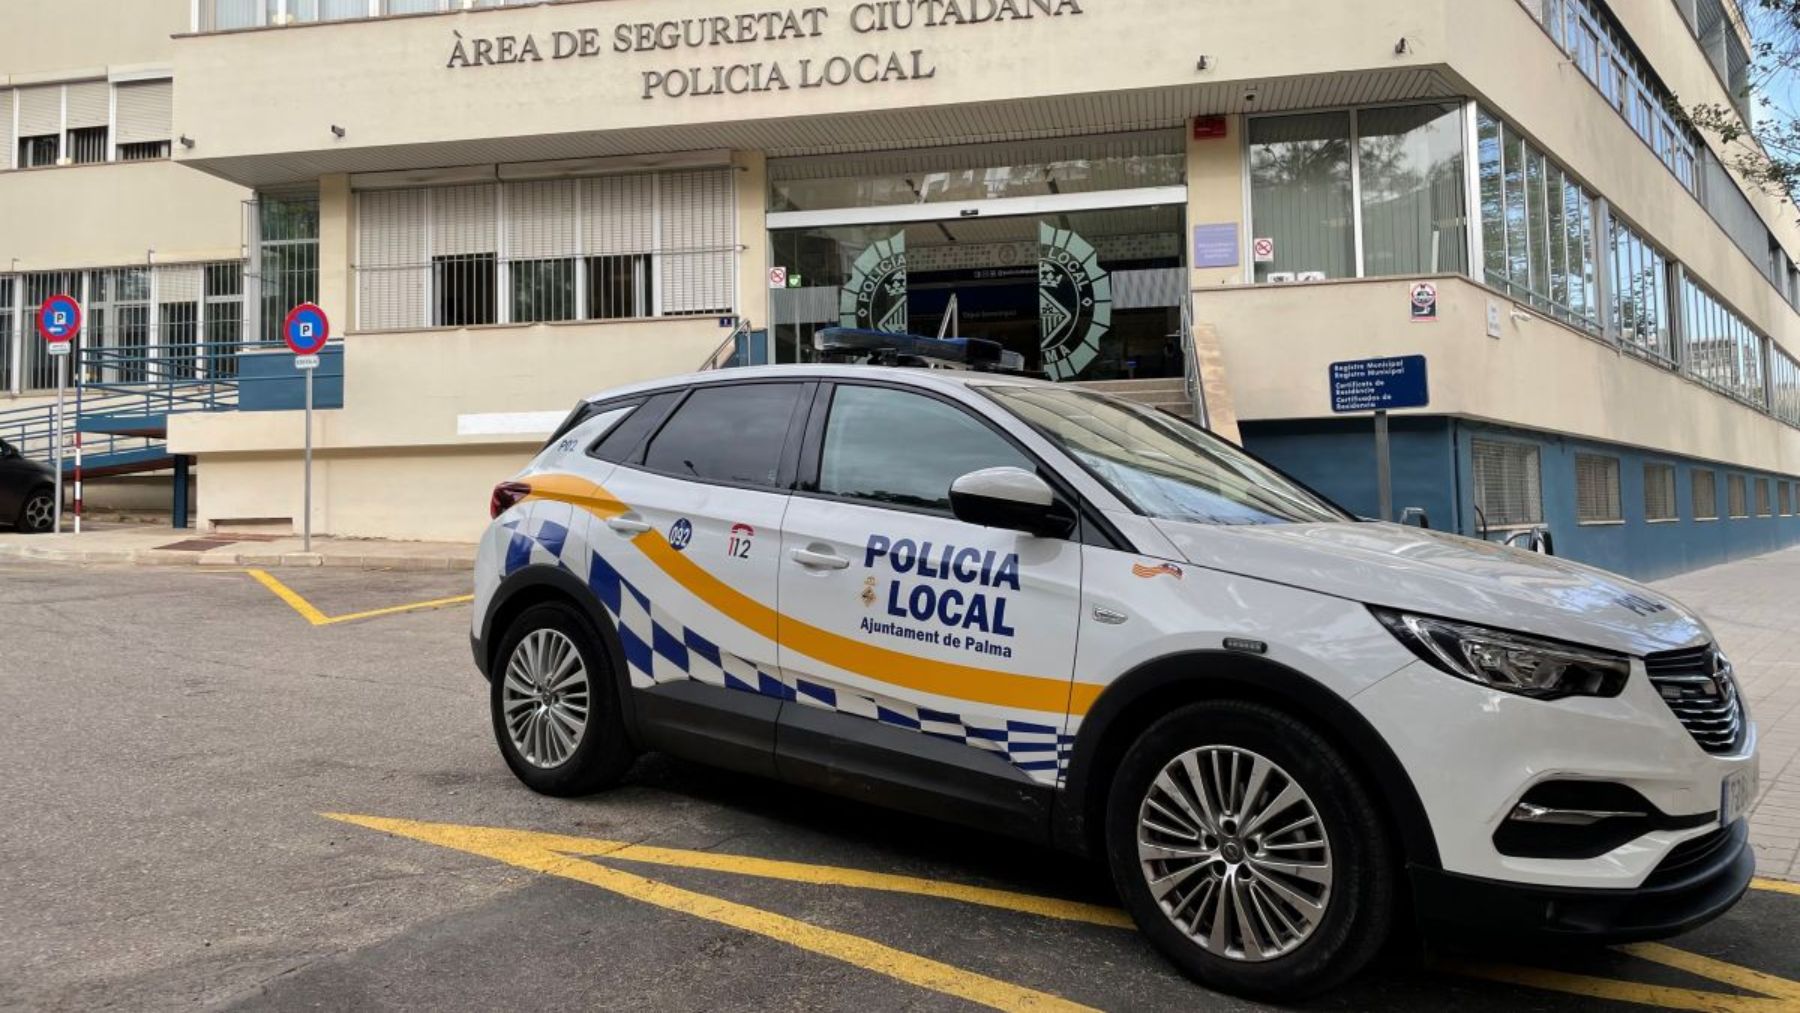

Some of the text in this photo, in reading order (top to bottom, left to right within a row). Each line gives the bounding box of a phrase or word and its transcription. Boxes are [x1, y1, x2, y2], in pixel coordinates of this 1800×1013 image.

[447, 29, 544, 68] ÀREA
[551, 28, 600, 59] DE
[613, 7, 828, 52] SEGURETAT
[641, 50, 936, 100] POLICIA LOCAL
[1048, 246, 1090, 292] LOCAL
[56, 313, 64, 323] P
[302, 325, 310, 335] P
[1366, 359, 1404, 369] Municipal
[1367, 367, 1405, 377] Municipal
[1375, 379, 1385, 387] de
[669, 526, 691, 546] 092
[728, 537, 752, 559] 112
[864, 533, 1021, 592] POLICIA
[887, 580, 1015, 637] LOCAL
[860, 616, 1012, 658] Ajuntament de Palma
